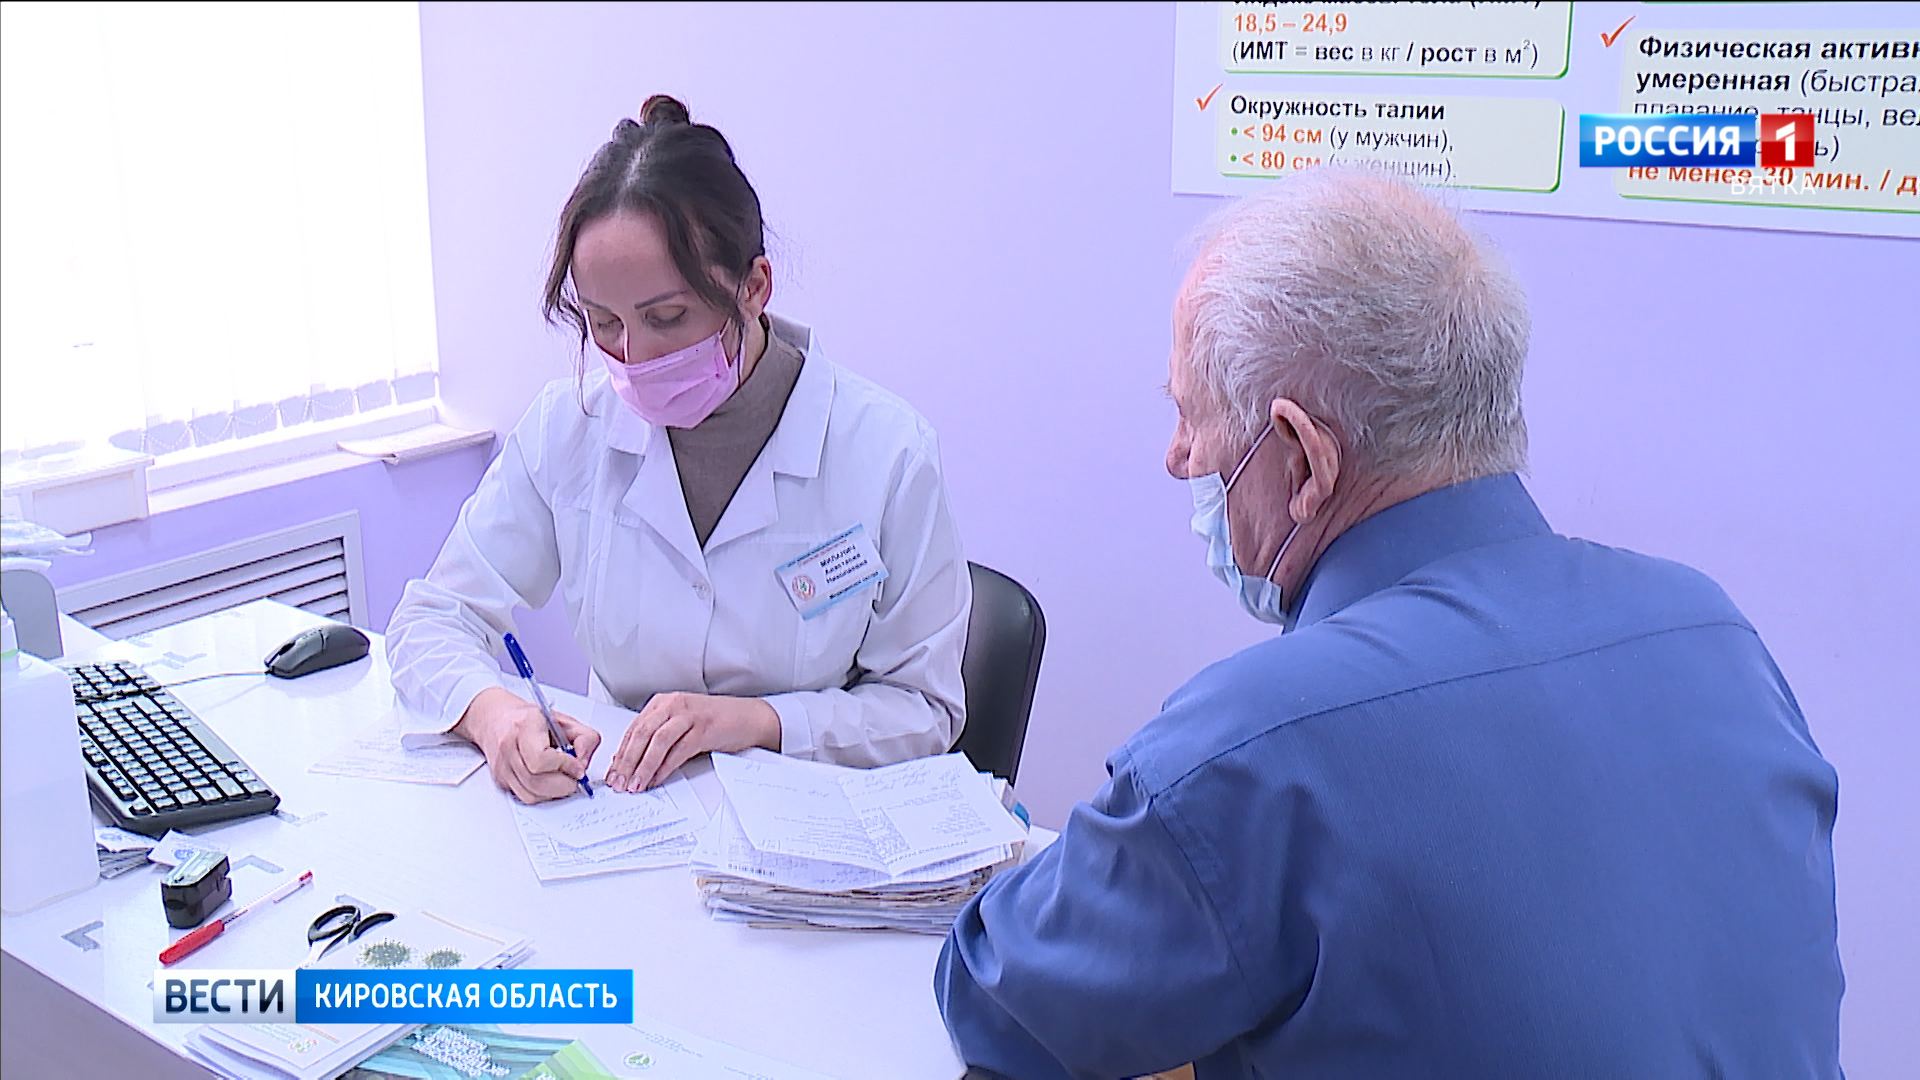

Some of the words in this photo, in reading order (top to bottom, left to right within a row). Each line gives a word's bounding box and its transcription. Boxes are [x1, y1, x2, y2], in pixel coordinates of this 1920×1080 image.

[1234, 13, 1276, 35] 18,5
[1302, 13, 1347, 35] 24,9
[1233, 41, 1288, 63] (ИМТ
[1315, 47, 1353, 61] вес
[1361, 48, 1373, 61] в
[1381, 47, 1400, 62] кг
[1406, 41, 1414, 62] /
[1421, 47, 1477, 66] рост
[1485, 48, 1497, 63] в
[1640, 36, 1811, 58] Физическая
[1636, 73, 1790, 93] умеренная
[1801, 69, 1920, 97] (быстра
[1231, 95, 1367, 119] Окружность
[1375, 103, 1444, 120] талии
[1882, 108, 1920, 127] ве
[1262, 123, 1286, 142] 94
[1293, 129, 1322, 143] см
[1330, 125, 1349, 150] (у
[1356, 130, 1453, 154] мужчин),
[1261, 150, 1285, 170] 80
[1628, 166, 1659, 180] не
[1668, 167, 1752, 184] менее
[1763, 166, 1794, 187] 30
[1804, 170, 1869, 191] мин.
[1896, 175, 1920, 196] д
